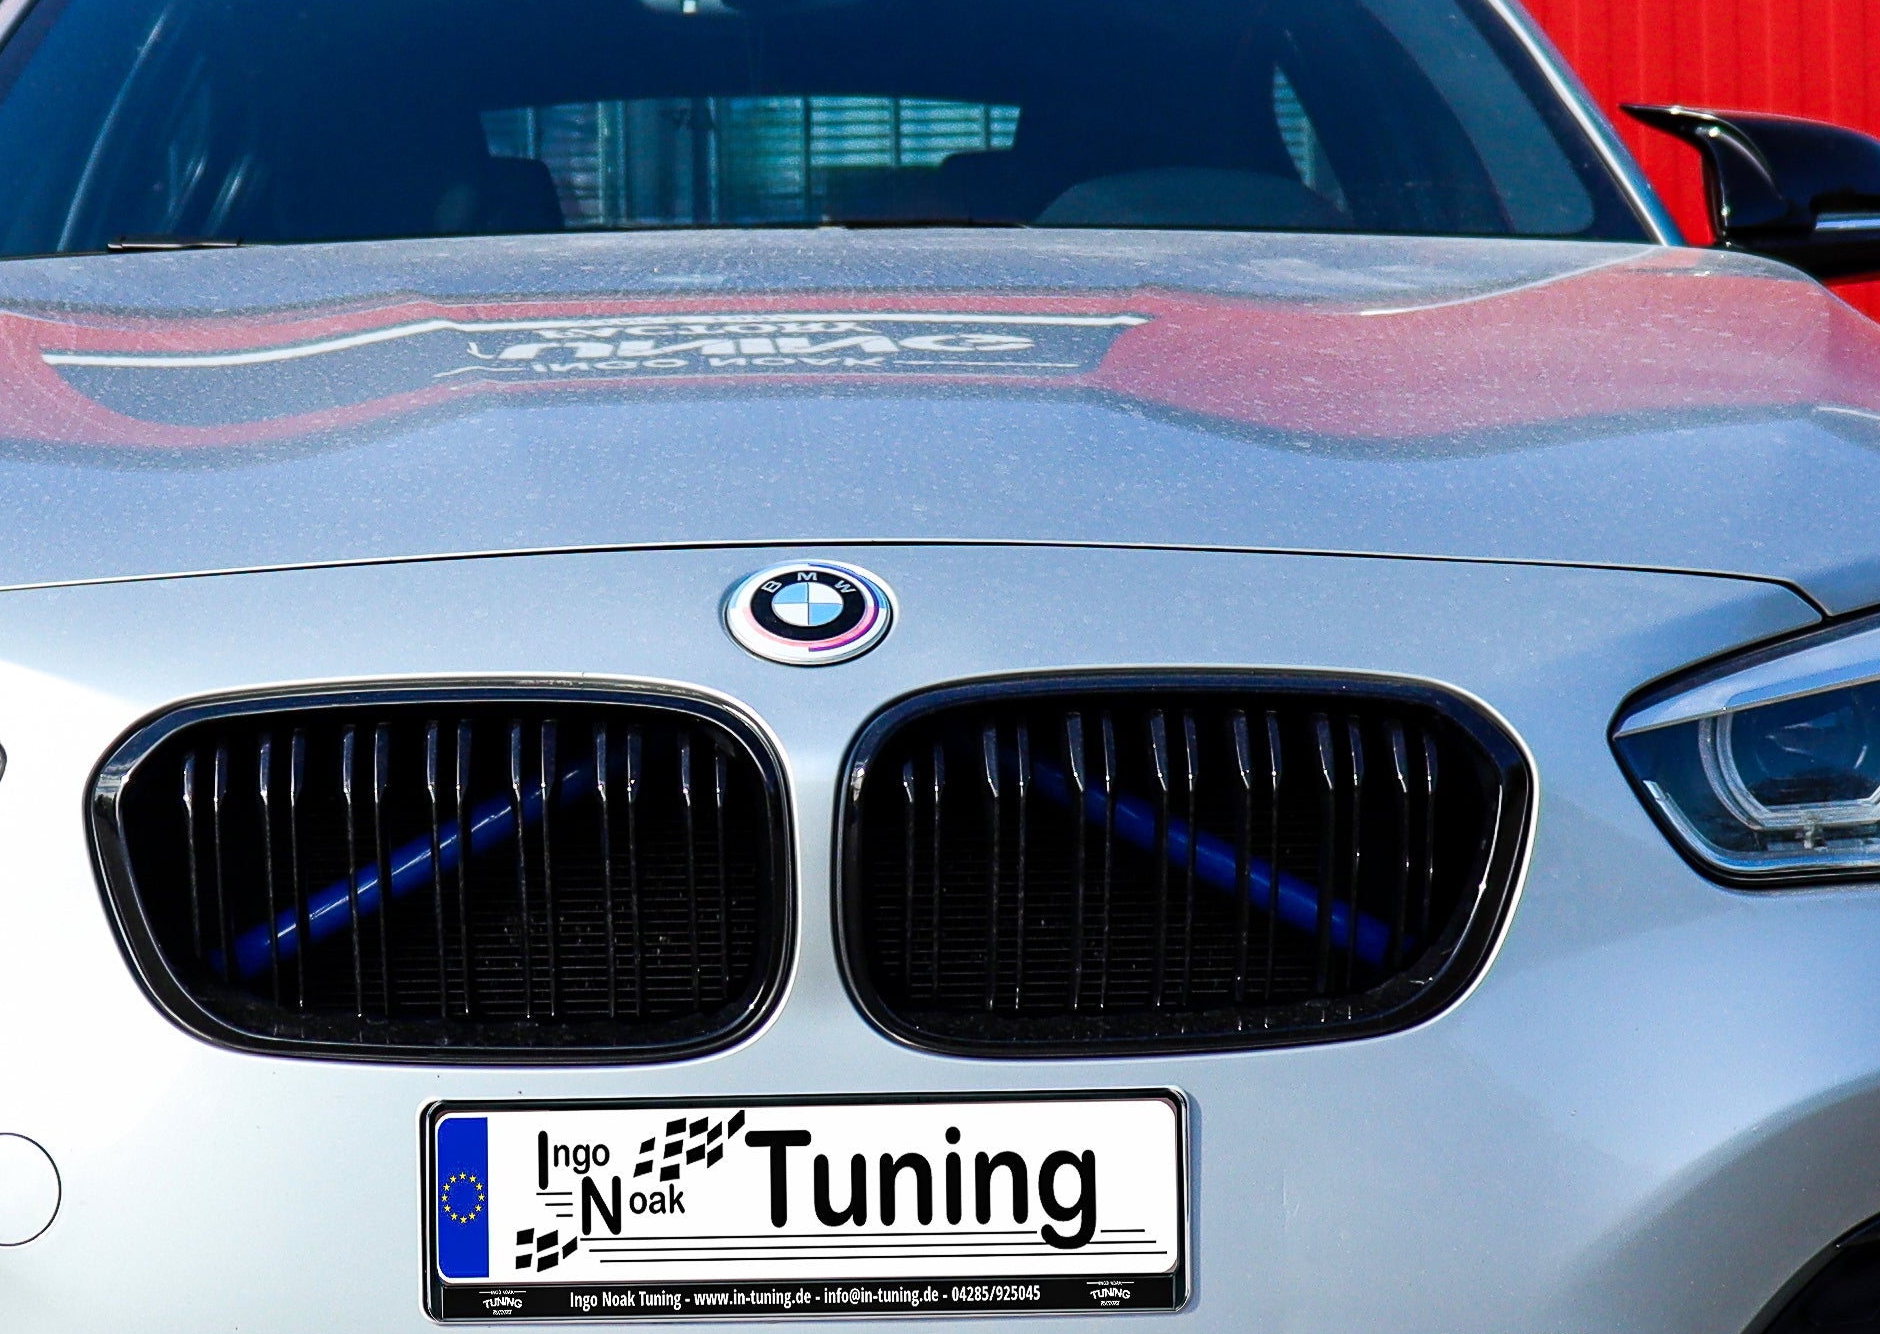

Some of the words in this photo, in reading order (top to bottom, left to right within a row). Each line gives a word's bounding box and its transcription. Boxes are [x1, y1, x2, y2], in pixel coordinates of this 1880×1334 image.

[760, 571, 857, 595] BMW
[537, 1130, 610, 1191] Ingo
[744, 1126, 1097, 1250] Tuning
[581, 1175, 686, 1236] Noak
[482, 1296, 523, 1309] TUNING
[570, 1291, 598, 1312] Ingo
[602, 1290, 636, 1307] Noak
[638, 1289, 682, 1311] Tuning
[693, 1287, 812, 1309] www.in-tuning.de
[824, 1285, 939, 1307] info@in-tuning.de
[951, 1284, 1041, 1302] 04285/925045
[1089, 1287, 1131, 1300] TUNING
